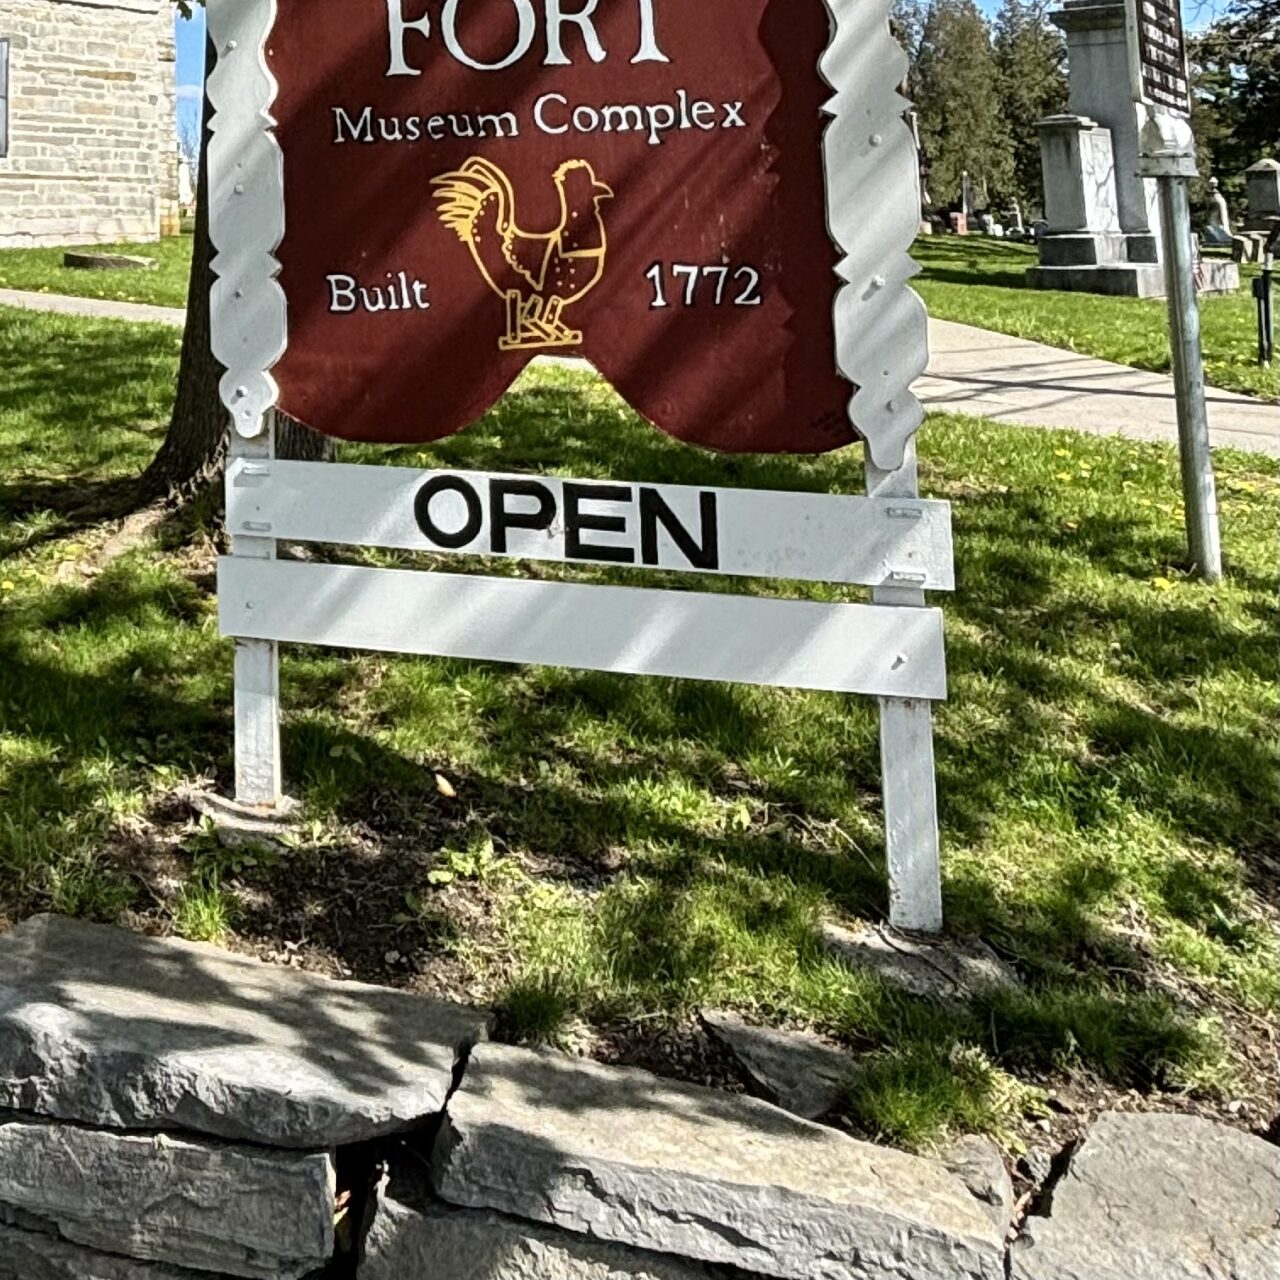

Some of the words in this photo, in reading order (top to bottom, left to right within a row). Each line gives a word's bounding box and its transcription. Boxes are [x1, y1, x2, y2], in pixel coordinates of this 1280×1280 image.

[332, 105, 519, 143] Museum
[532, 89, 747, 145] Complex
[326, 270, 430, 313] Built
[645, 264, 762, 307] 1772
[413, 473, 720, 571] OPEN
